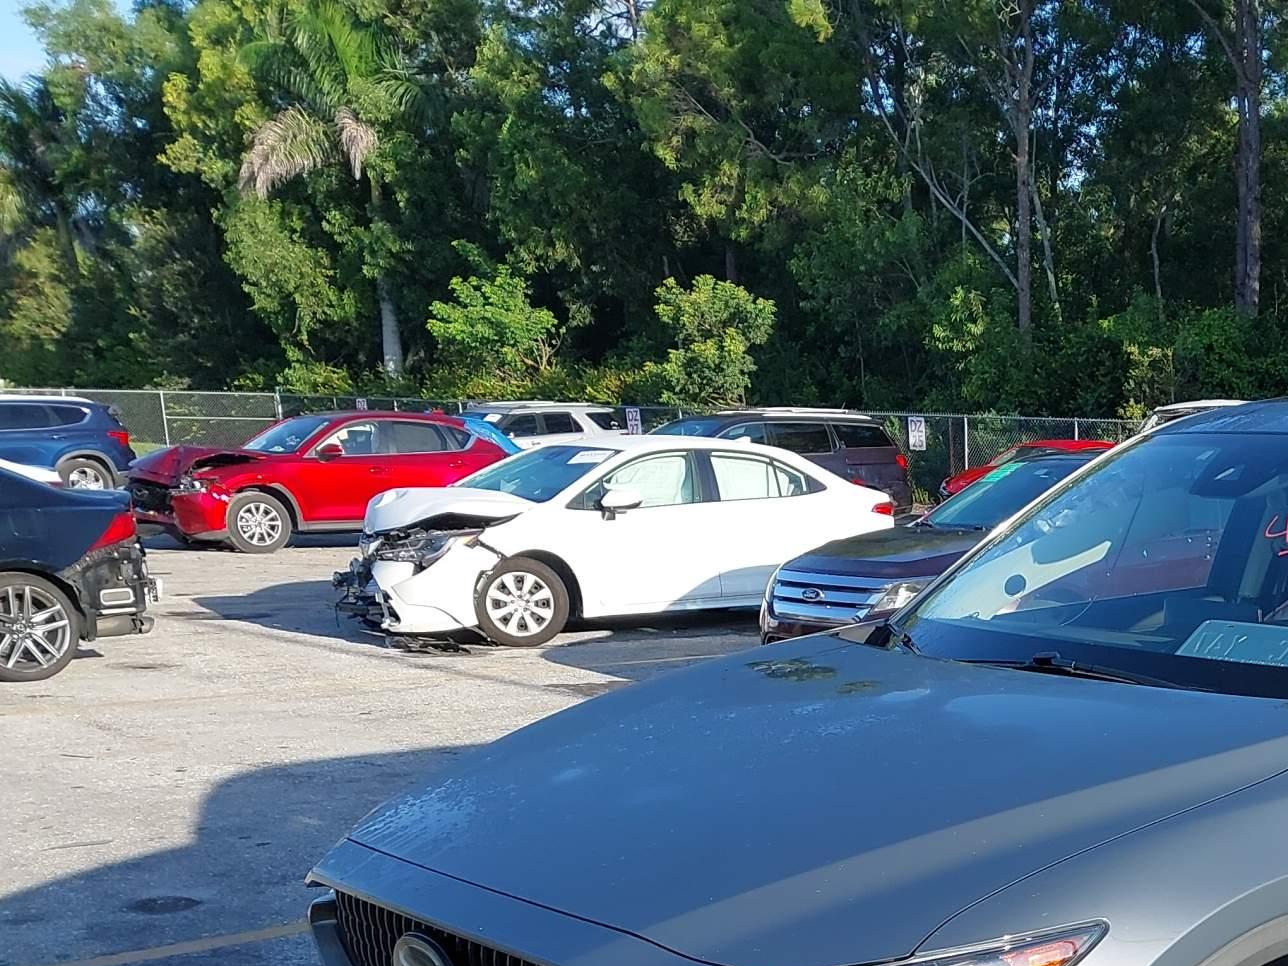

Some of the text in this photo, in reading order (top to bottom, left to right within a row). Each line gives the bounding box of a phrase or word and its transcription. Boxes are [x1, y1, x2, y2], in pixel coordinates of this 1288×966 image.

[628, 410, 639, 421] DZ
[910, 420, 923, 432] DZ
[912, 435, 923, 448] 25
